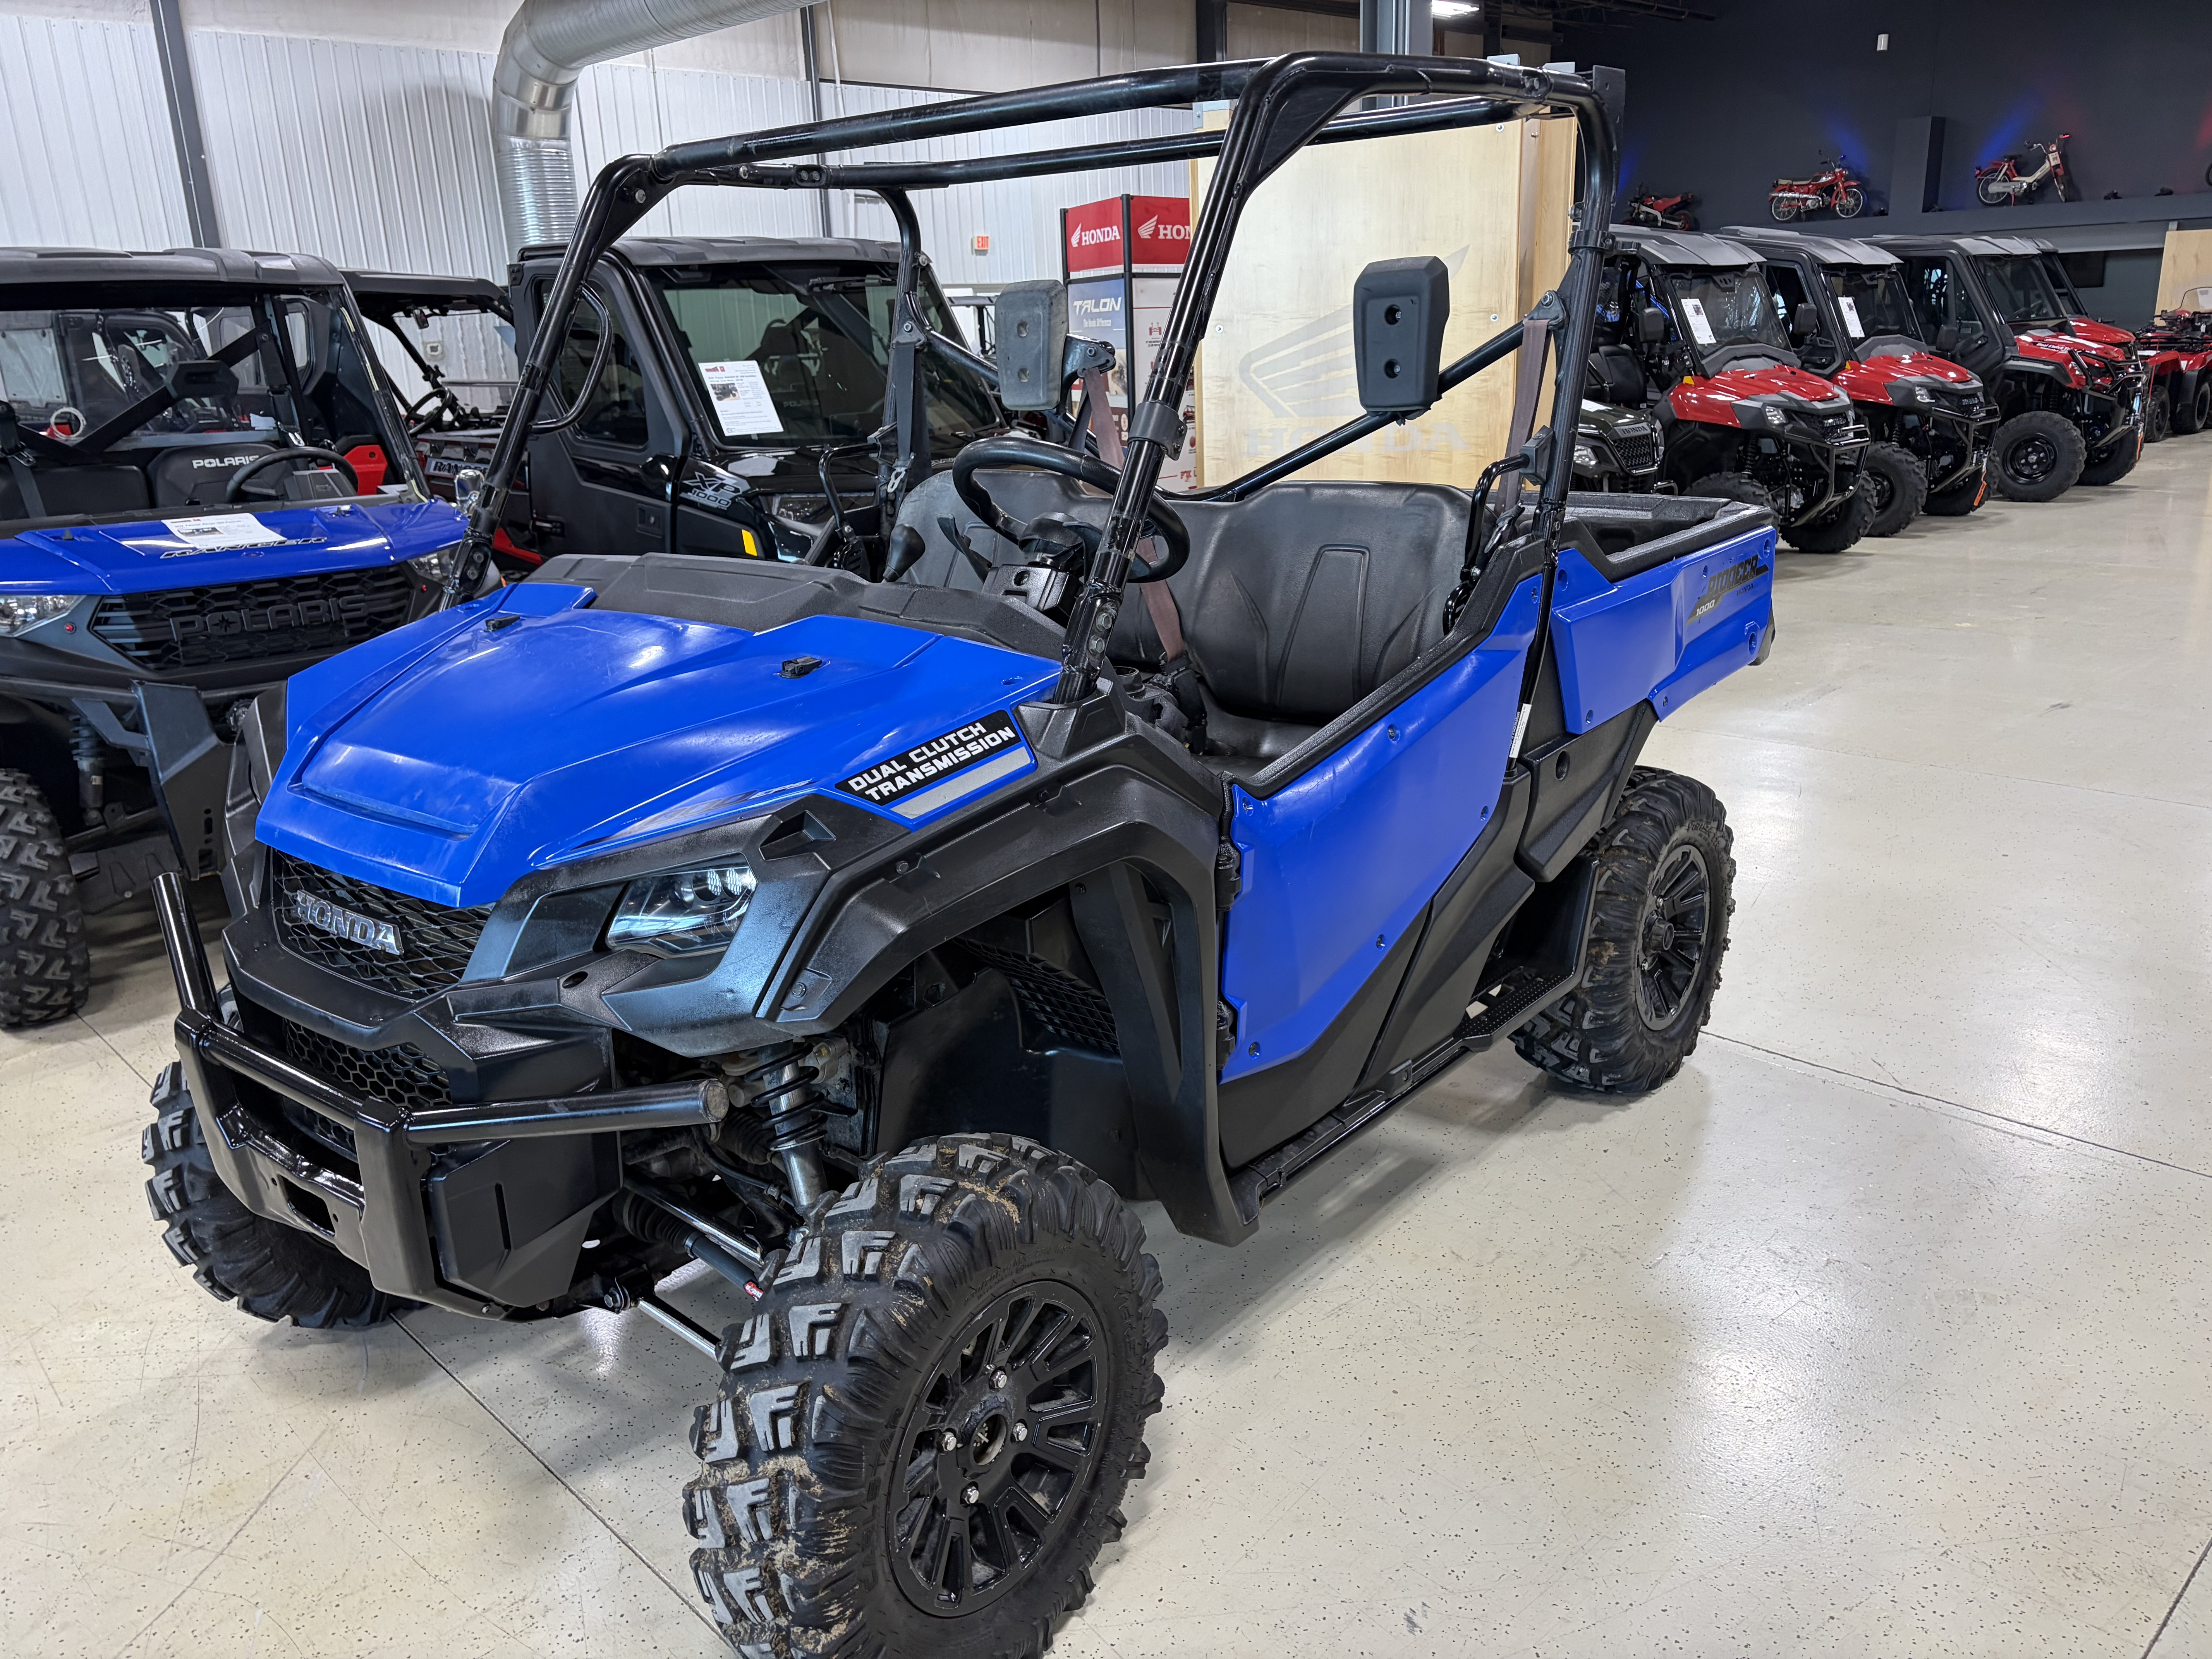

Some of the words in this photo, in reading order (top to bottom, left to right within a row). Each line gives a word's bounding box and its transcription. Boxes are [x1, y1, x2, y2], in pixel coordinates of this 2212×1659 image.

[977, 236, 989, 248] EXIT
[1082, 225, 1120, 246] HONDA
[1073, 297, 1121, 316] TALON
[1622, 426, 1648, 434] HONDA
[682, 471, 742, 495] XP
[692, 488, 732, 507] 1000
[1706, 554, 1759, 599] PIONEER
[1736, 584, 1754, 596] HONDA
[170, 594, 368, 642] POLARIS
[1696, 599, 1715, 616] 1000
[848, 760, 907, 792] DUAL
[908, 722, 987, 763] CLUTCH
[865, 726, 1016, 800] TRANSMISSION
[294, 890, 404, 955] HONDA
